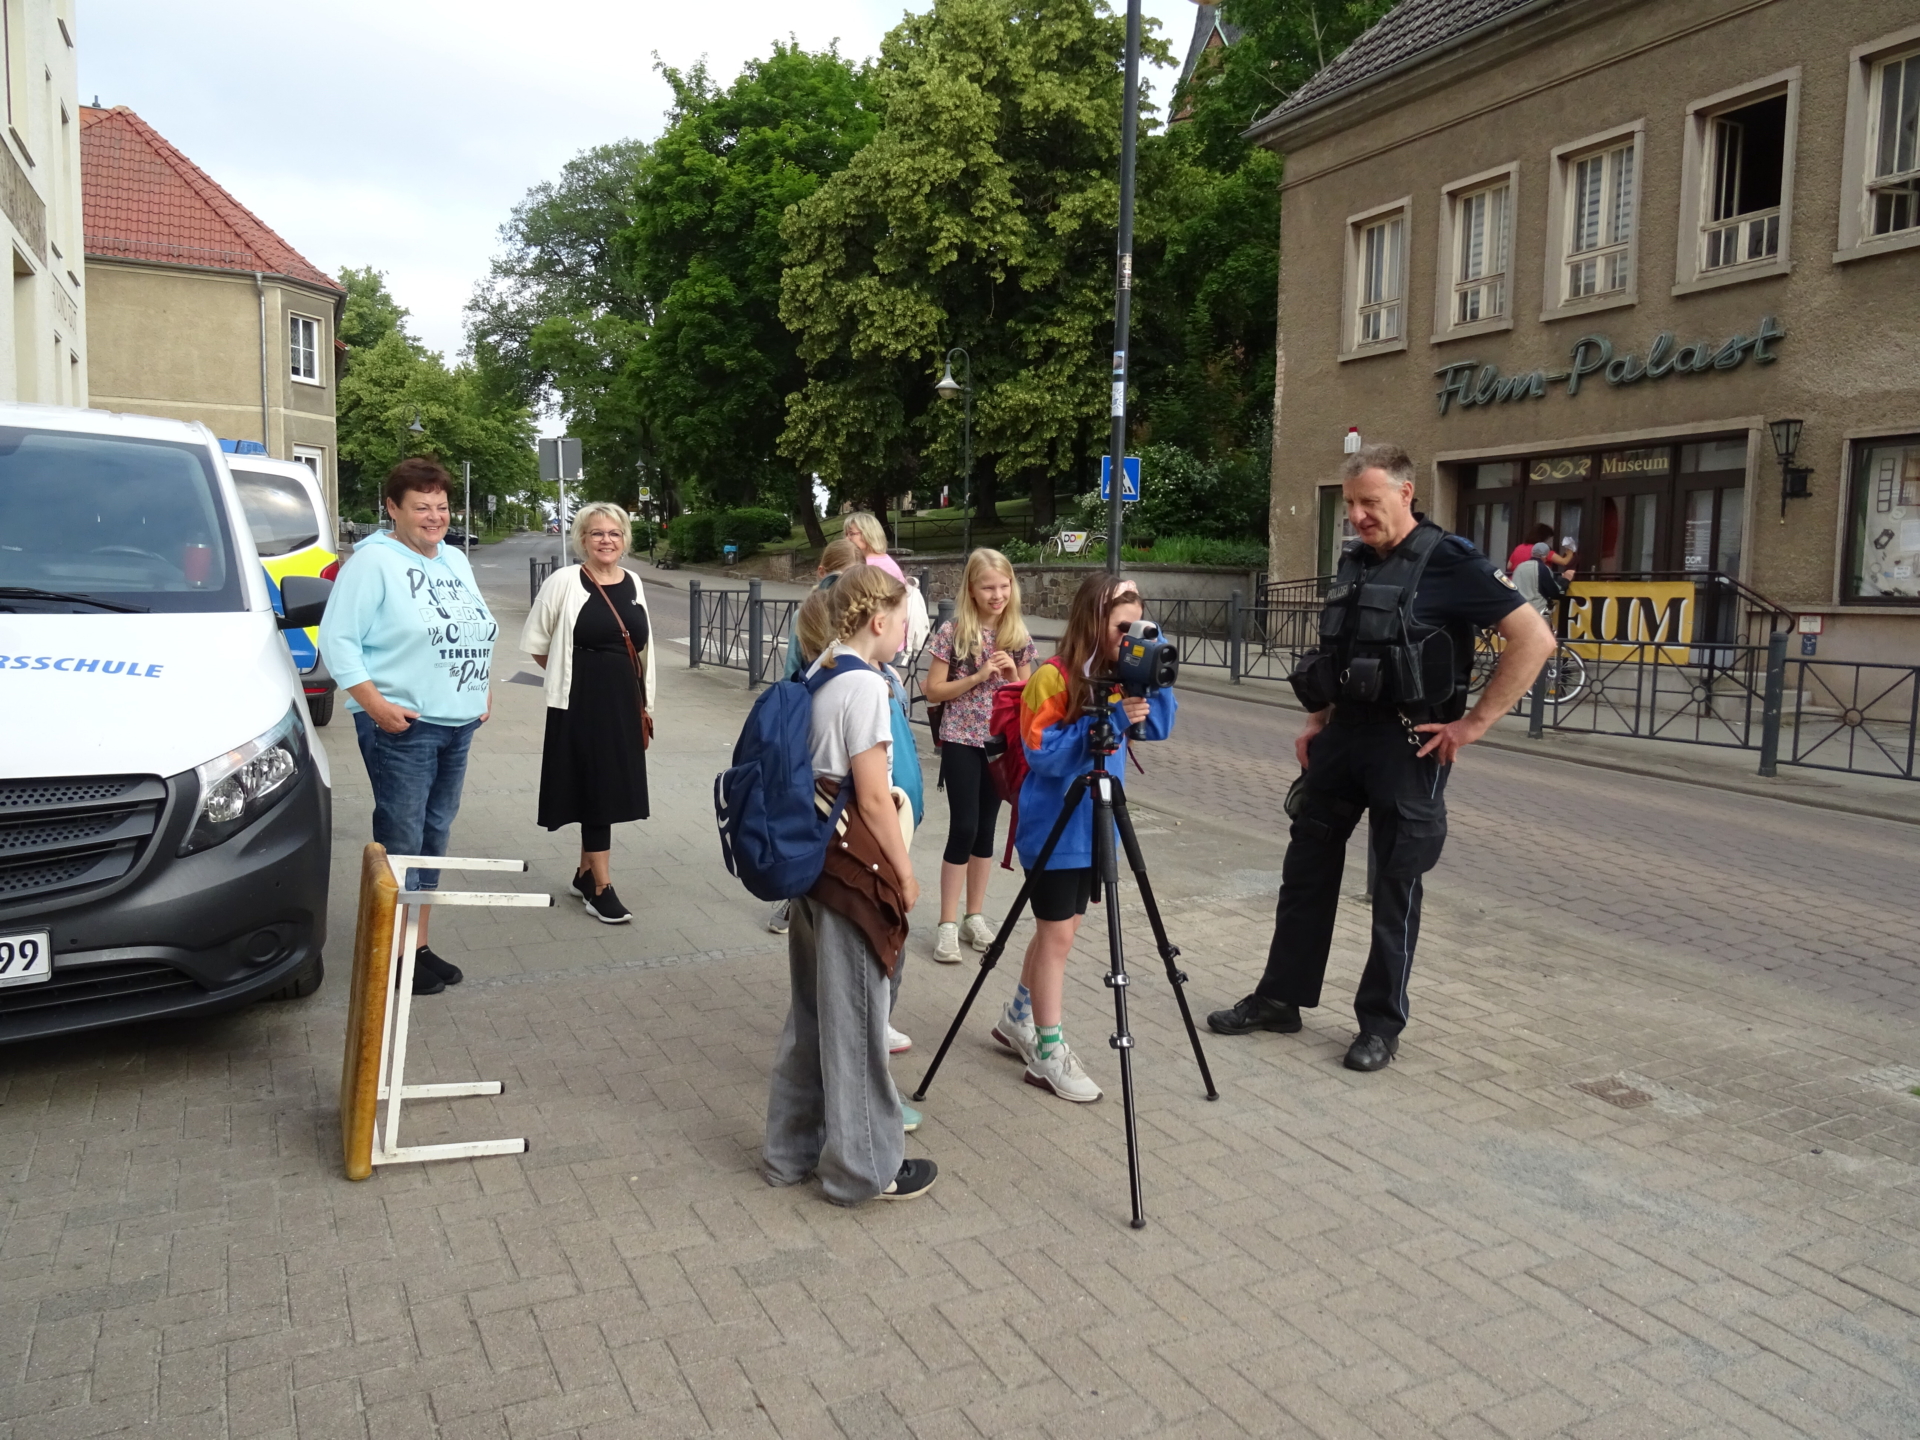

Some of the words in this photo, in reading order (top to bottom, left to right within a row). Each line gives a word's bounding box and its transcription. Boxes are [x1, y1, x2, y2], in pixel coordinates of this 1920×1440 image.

[1434, 316, 1785, 415] Film-Palast
[1530, 458, 1592, 481] DDR
[1601, 456, 1669, 475] Museum
[406, 567, 463, 599] Playa
[445, 621, 497, 647] CRUZ
